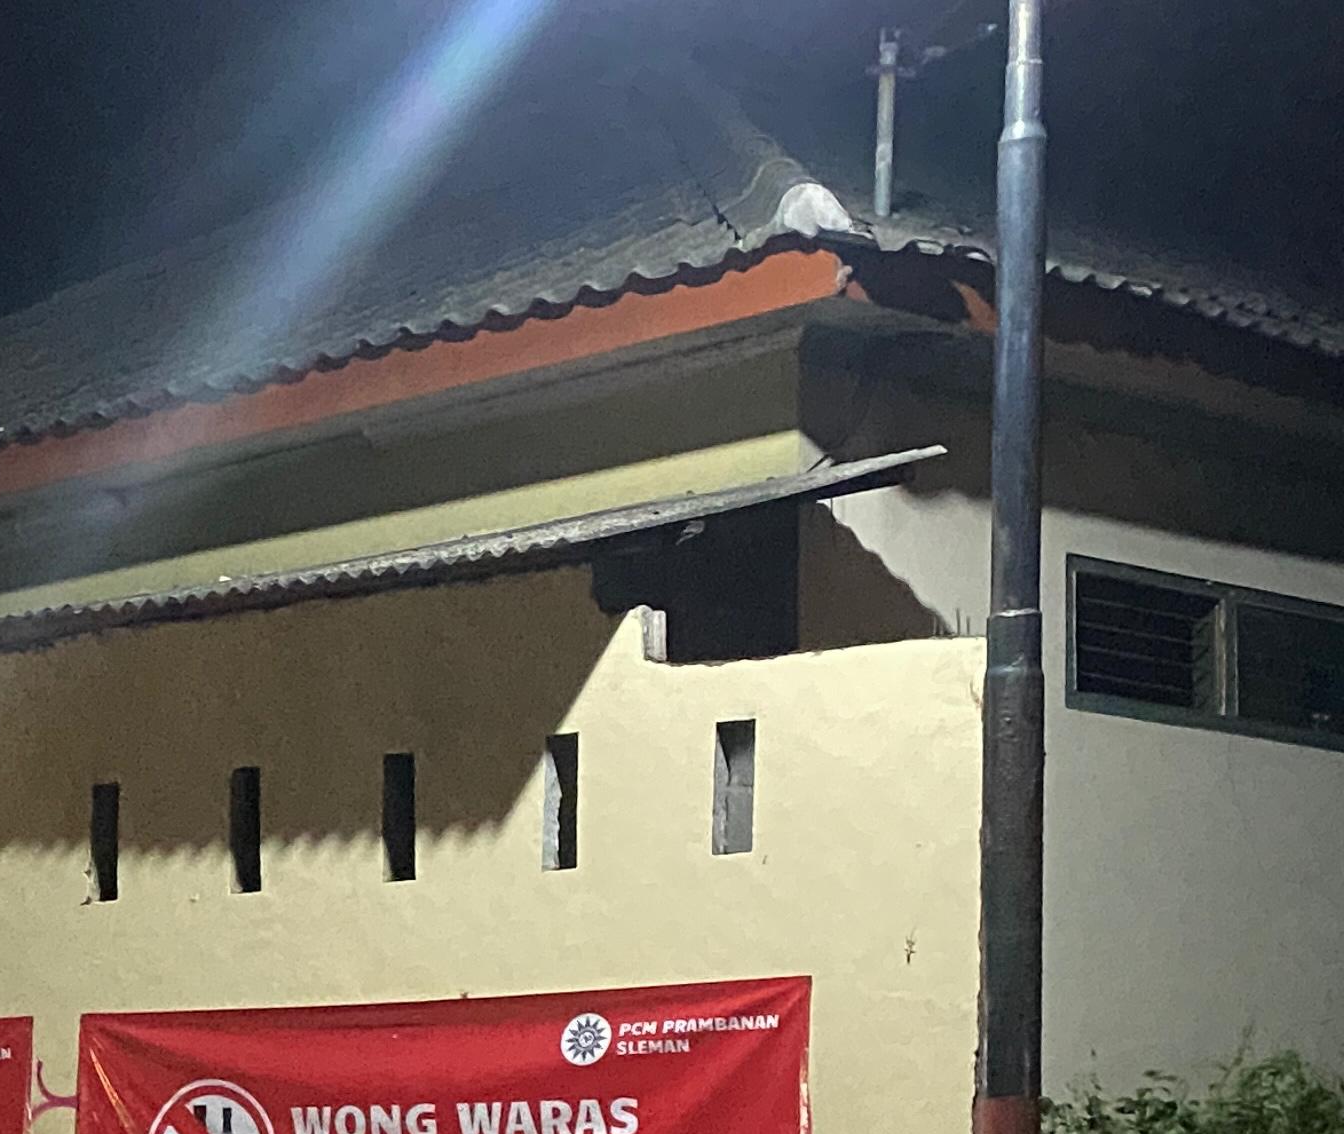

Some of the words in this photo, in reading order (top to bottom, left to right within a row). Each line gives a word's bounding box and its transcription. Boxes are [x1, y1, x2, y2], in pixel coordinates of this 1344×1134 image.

[618, 1020, 657, 1036] PCM
[662, 1014, 780, 1034] PRAMBANAN
[616, 1038, 690, 1055] SLEMAN
